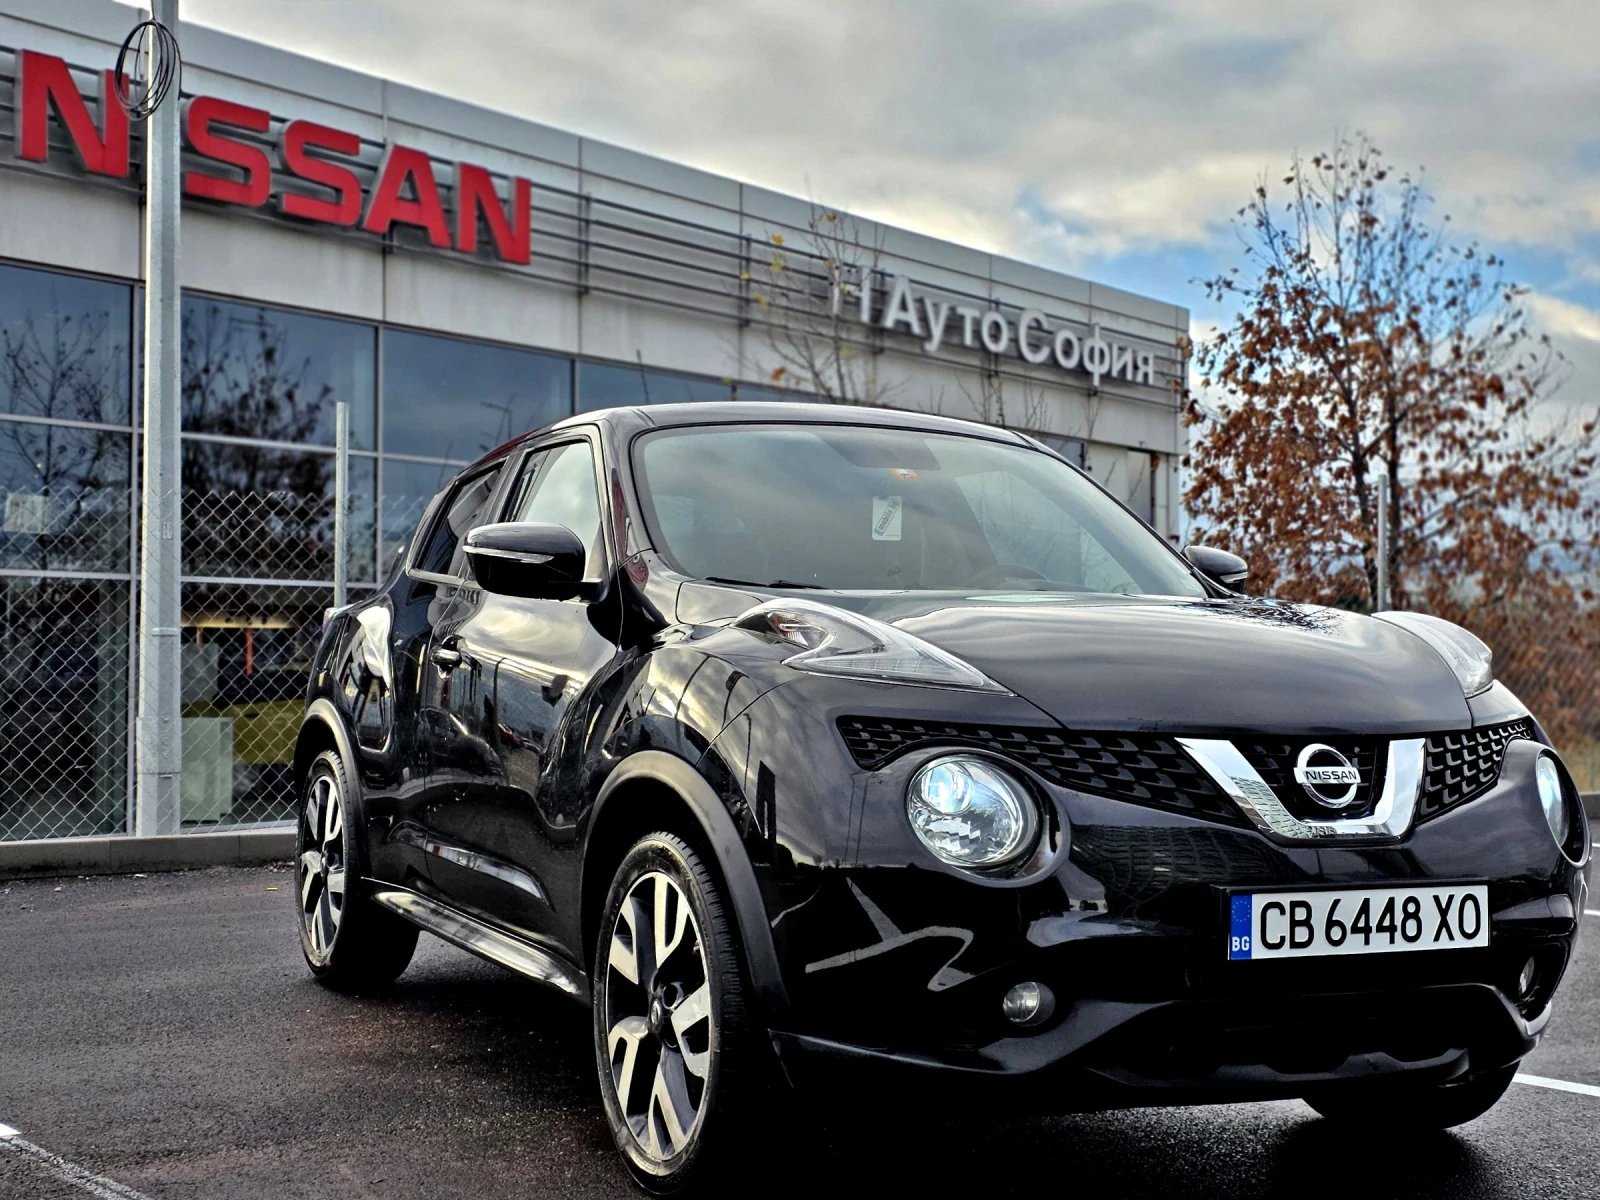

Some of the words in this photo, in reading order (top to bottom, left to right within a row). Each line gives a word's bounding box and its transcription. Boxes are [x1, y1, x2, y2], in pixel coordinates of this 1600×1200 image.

[18, 49, 532, 266] NSSAN
[1018, 308, 1155, 387] София
[1305, 770, 1357, 781] NISSAN
[1231, 936, 1250, 951] BG
[1260, 900, 1315, 950] CB
[1325, 896, 1423, 947] 6448
[1432, 893, 1481, 942] XO
